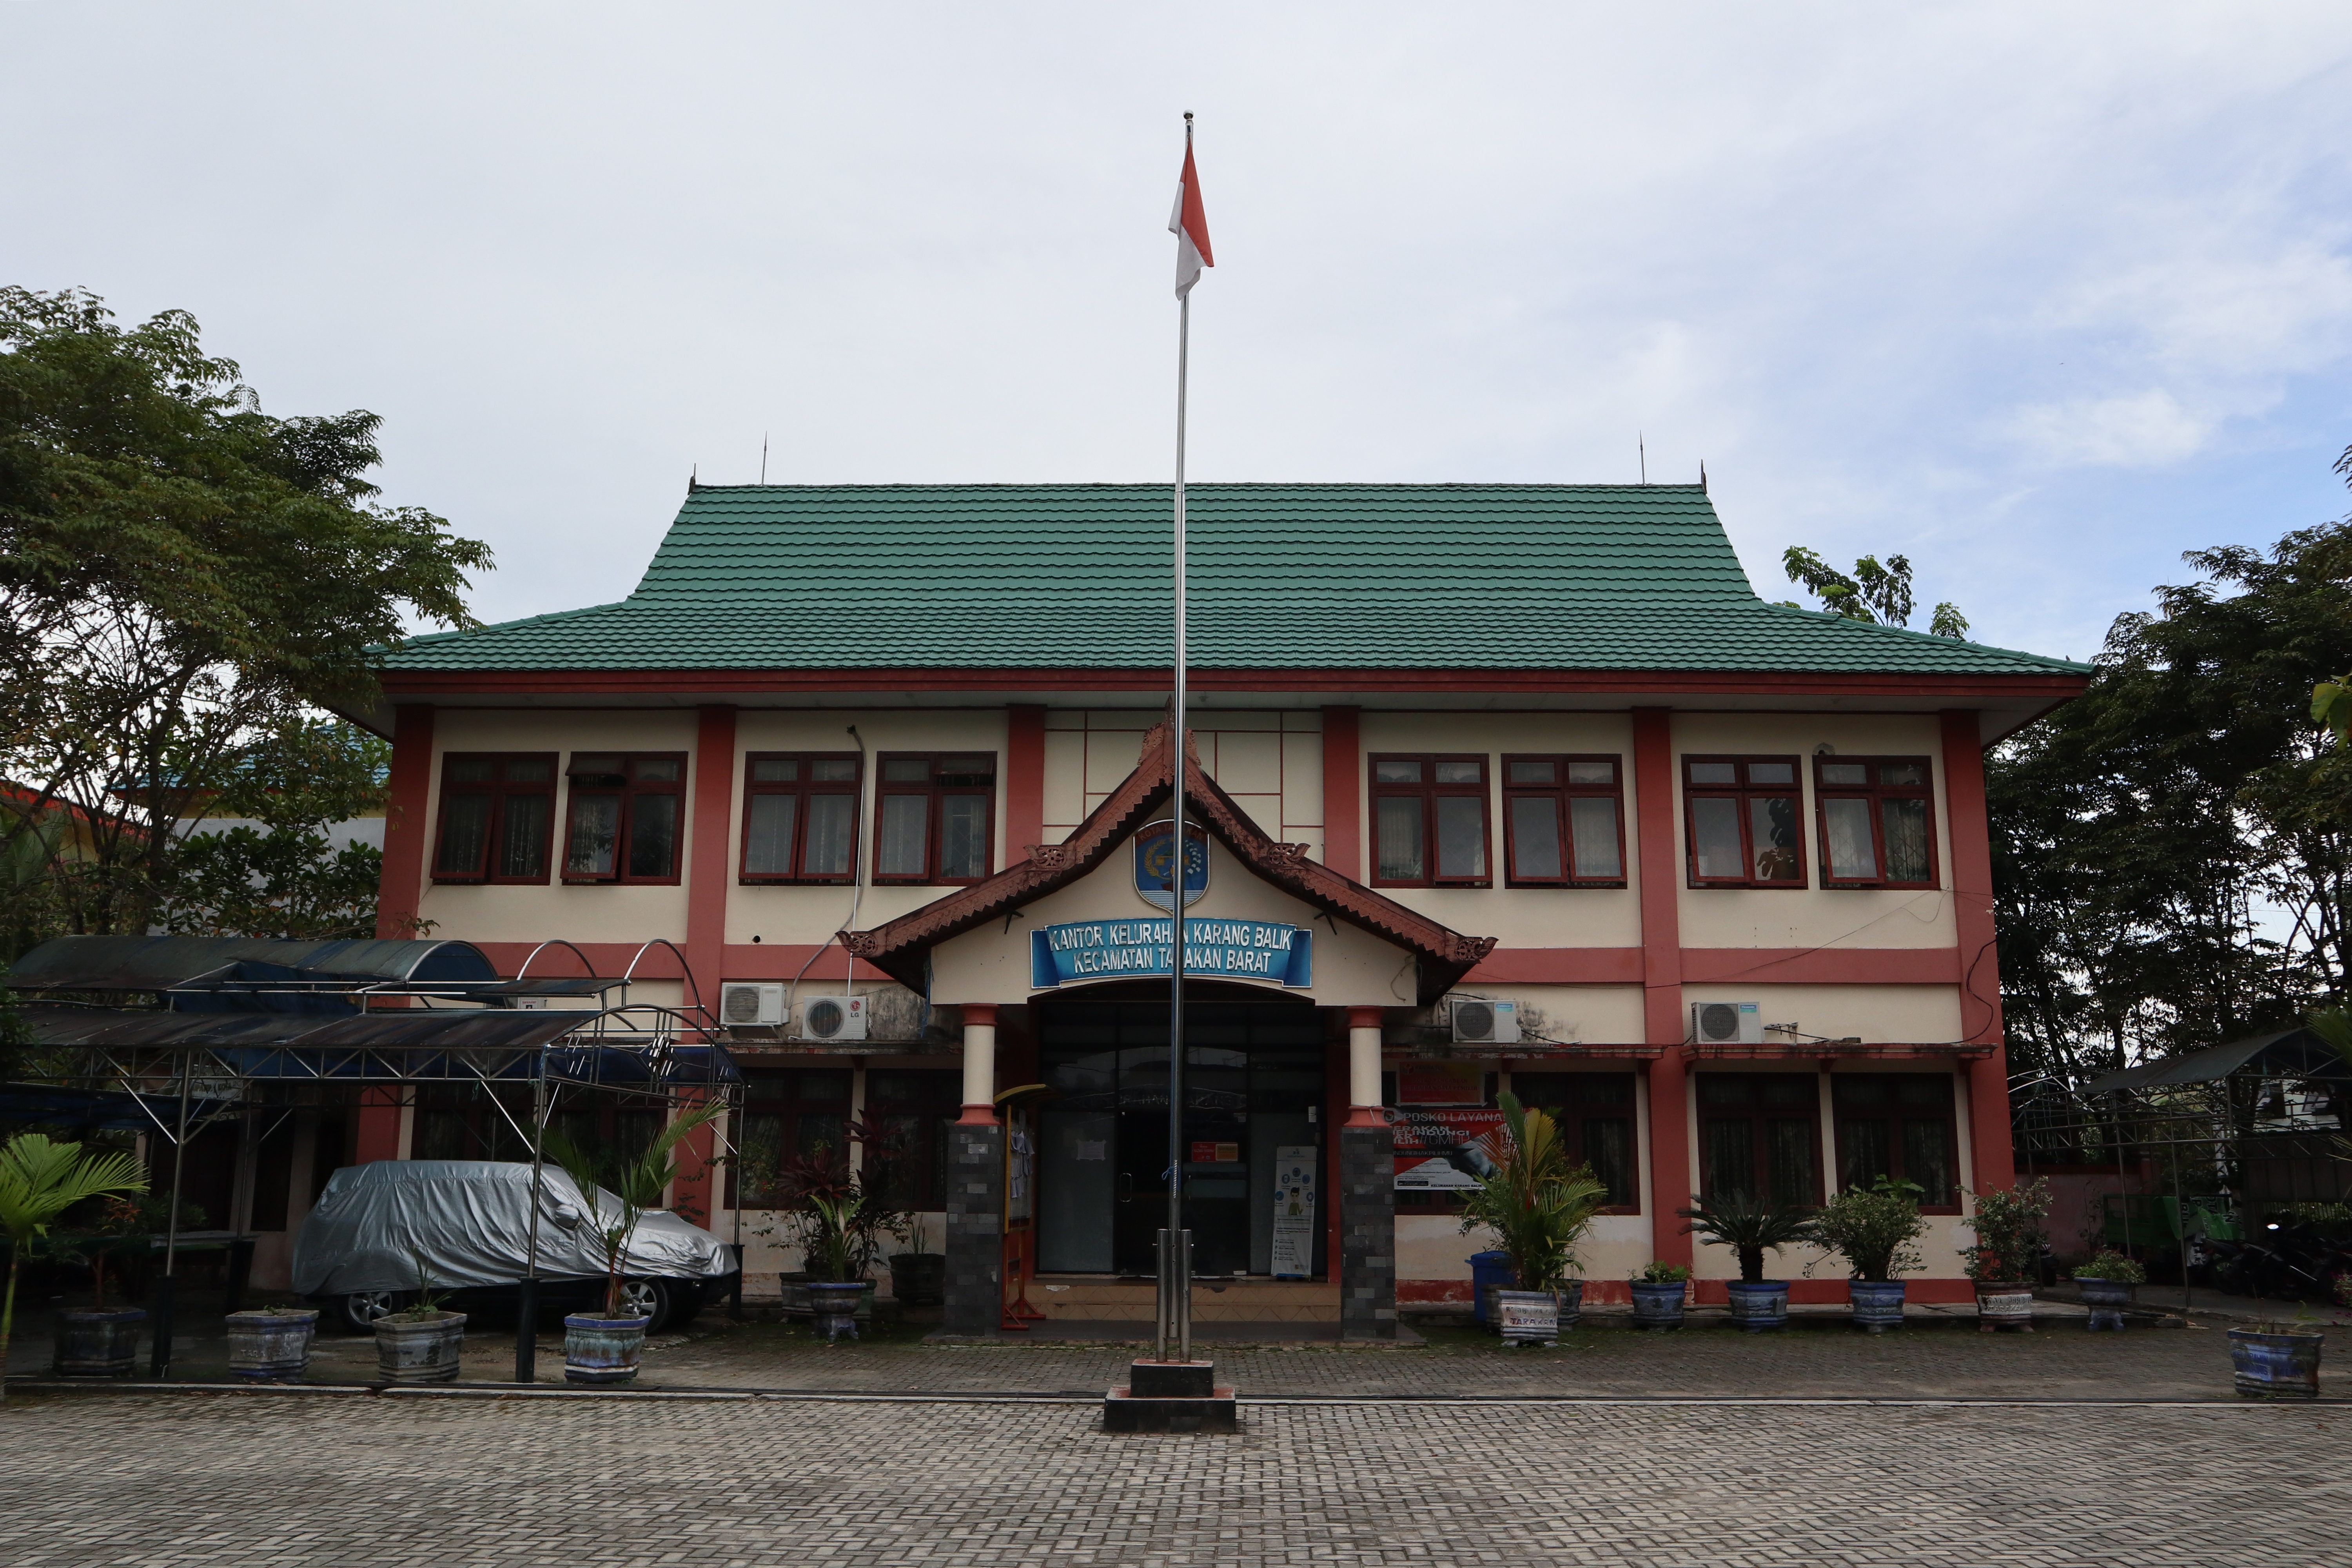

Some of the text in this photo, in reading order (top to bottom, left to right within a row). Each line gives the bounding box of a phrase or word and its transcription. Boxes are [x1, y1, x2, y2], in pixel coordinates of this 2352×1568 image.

[1048, 923, 1293, 951] KANTOR KELURAHN KARANG BALIK
[1074, 947, 1272, 973] KECAMATAN TAAKAN BARAT
[1403, 1113, 1505, 1122] POSKO LAYANA
[1510, 1317, 1555, 1325] TARAKAN
